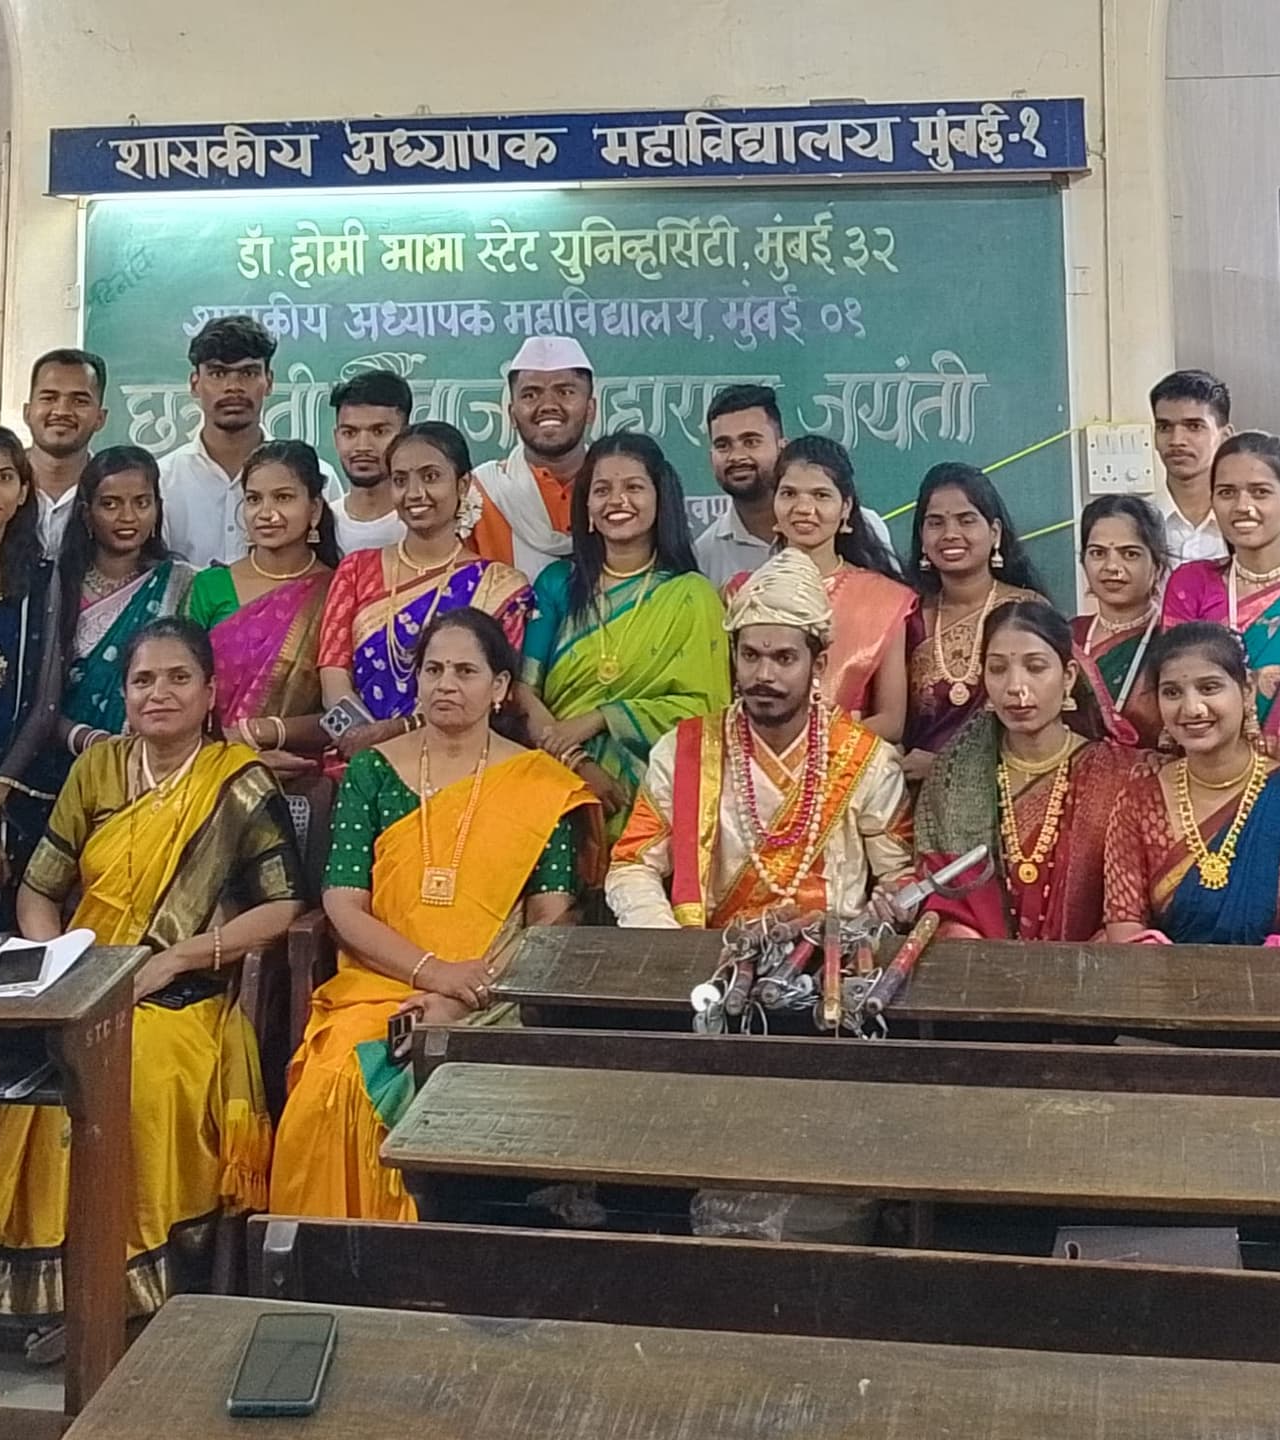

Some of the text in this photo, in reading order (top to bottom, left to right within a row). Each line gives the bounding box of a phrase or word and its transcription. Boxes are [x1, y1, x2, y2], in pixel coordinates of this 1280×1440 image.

[111, 125, 320, 179] शासकीय
[344, 126, 568, 175] अध्यापक
[595, 111, 901, 168] महाविद्यालय
[290, 219, 369, 287] होमी
[379, 231, 466, 276] भाभा
[476, 220, 540, 272] स्टेट
[754, 210, 837, 283] मुंबई
[841, 226, 899, 277] ३२
[344, 299, 496, 342] अध्यापक
[719, 279, 808, 351] मुंबई
[798, 350, 992, 450] जयंती
